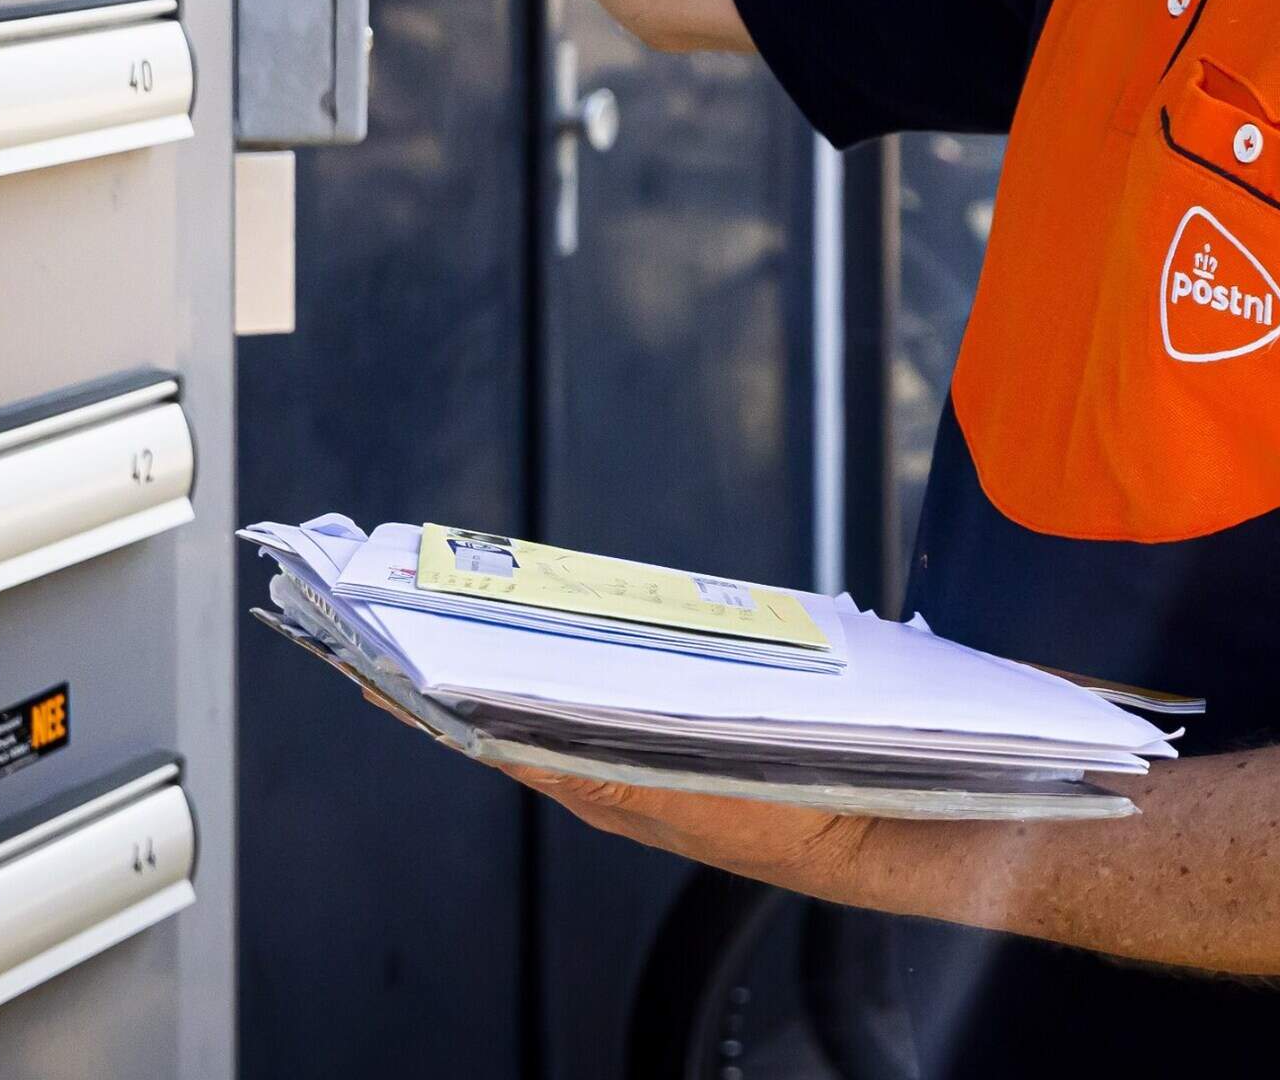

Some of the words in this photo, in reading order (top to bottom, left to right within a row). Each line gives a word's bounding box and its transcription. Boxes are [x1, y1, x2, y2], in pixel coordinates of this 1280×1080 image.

[129, 60, 153, 92] 40
[1171, 271, 1273, 326] postnl
[132, 448, 154, 483] 42
[31, 693, 66, 749] NEE
[133, 837, 157, 873] 44
